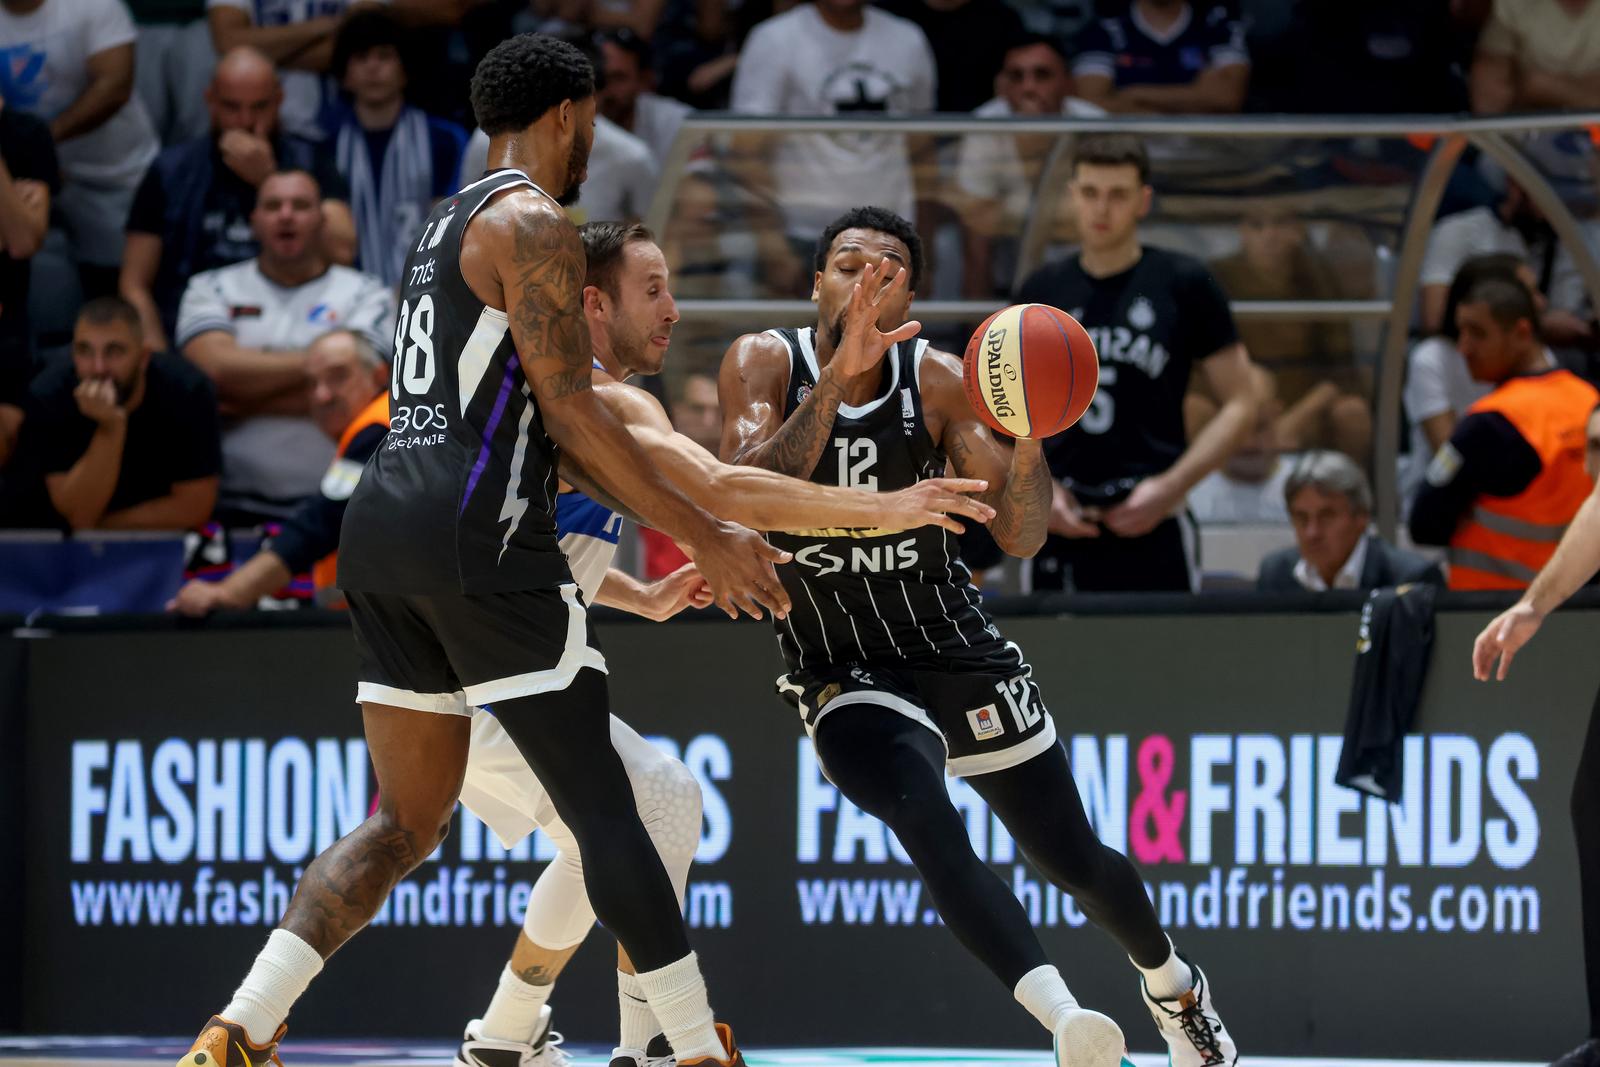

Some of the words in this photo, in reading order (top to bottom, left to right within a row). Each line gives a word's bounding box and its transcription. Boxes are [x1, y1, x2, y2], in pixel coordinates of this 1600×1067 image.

[988, 328, 1016, 418] SPALDING
[835, 437, 878, 493] 12
[851, 538, 919, 574] NIS
[995, 675, 1041, 733] 12
